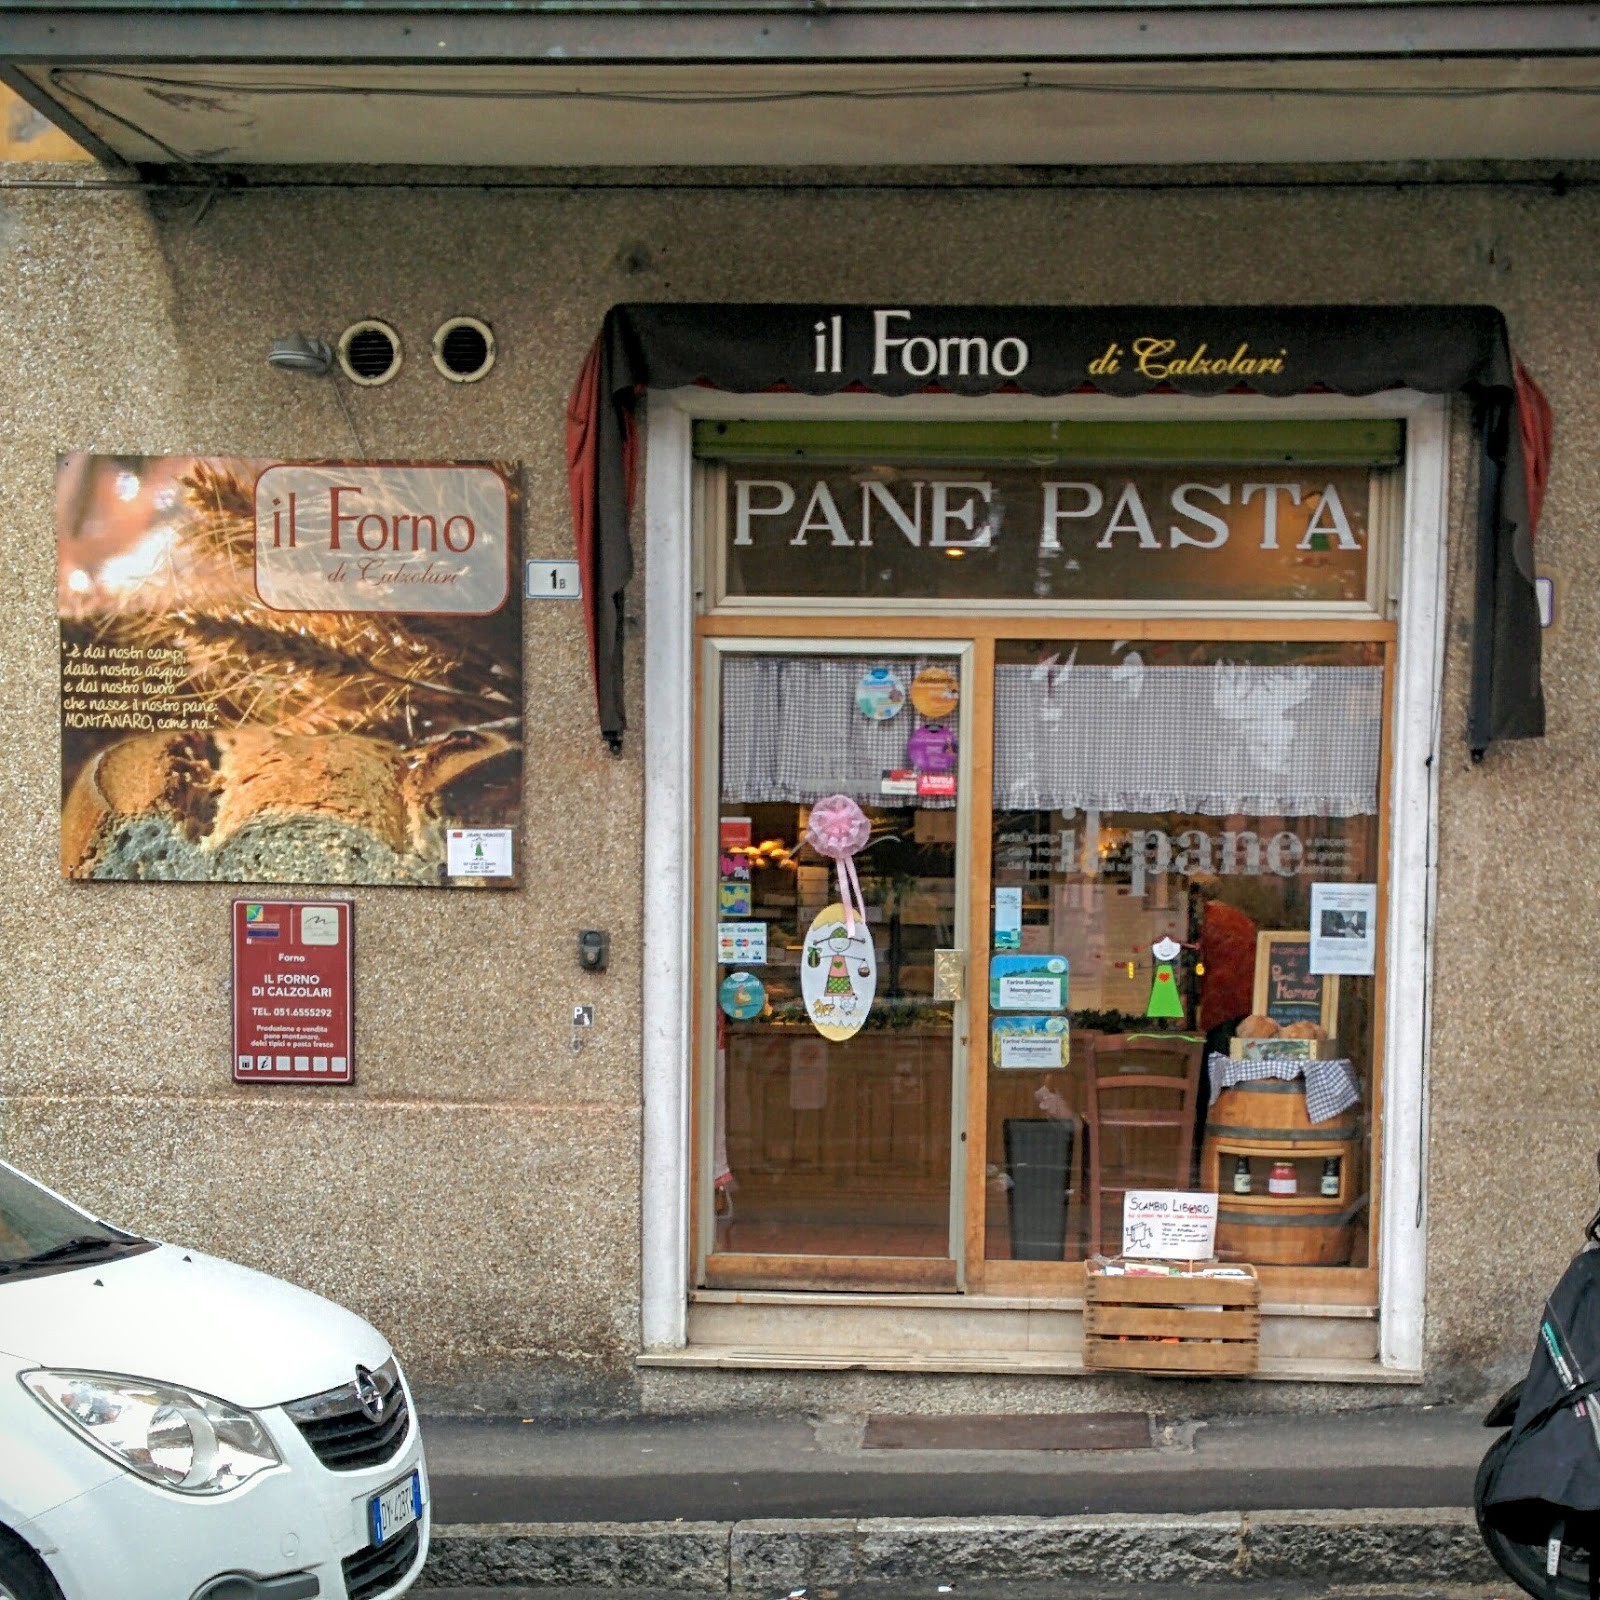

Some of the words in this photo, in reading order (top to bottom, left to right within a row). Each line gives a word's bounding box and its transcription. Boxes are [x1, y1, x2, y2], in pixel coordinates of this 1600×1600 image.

[814, 315, 842, 373] il
[872, 309, 1029, 376] Forno
[1088, 342, 1123, 375] di
[1132, 337, 1289, 379] Calzolari
[272, 492, 297, 548] il
[329, 487, 475, 553] Forno
[734, 480, 992, 549] PANE
[1040, 482, 1362, 551] PASTA
[327, 561, 347, 583] di
[356, 557, 460, 586] Calzolari
[83, 644, 106, 659] dai
[109, 645, 144, 660] nostri
[147, 648, 187, 665] campi,
[63, 661, 98, 676] dalla
[100, 662, 143, 677] nostra
[145, 666, 187, 685] acqua
[63, 682, 73, 693] e
[76, 678, 98, 693] dal
[101, 679, 140, 694] nostro
[143, 680, 176, 695] lavoro
[63, 697, 88, 711] che
[89, 699, 130, 711] nasce
[132, 698, 138, 711] il
[141, 698, 180, 712] nostro
[182, 702, 219, 717] pane:
[65, 712, 155, 733] MONTANARO,
[157, 718, 189, 730] come
[1057, 804, 1103, 874] il
[1129, 830, 1304, 897] pane
[278, 952, 306, 962] Forno
[263, 974, 275, 984] IL
[277, 974, 320, 985] FORNO
[251, 986, 265, 997] DI
[267, 986, 332, 998] CALZOLARI
[252, 1007, 272, 1016] TEL.
[273, 1008, 332, 1018] 051.6555292
[574, 1006, 583, 1019] P
[302, 1025, 328, 1033] vendita
[268, 1040, 286, 1048] tipici
